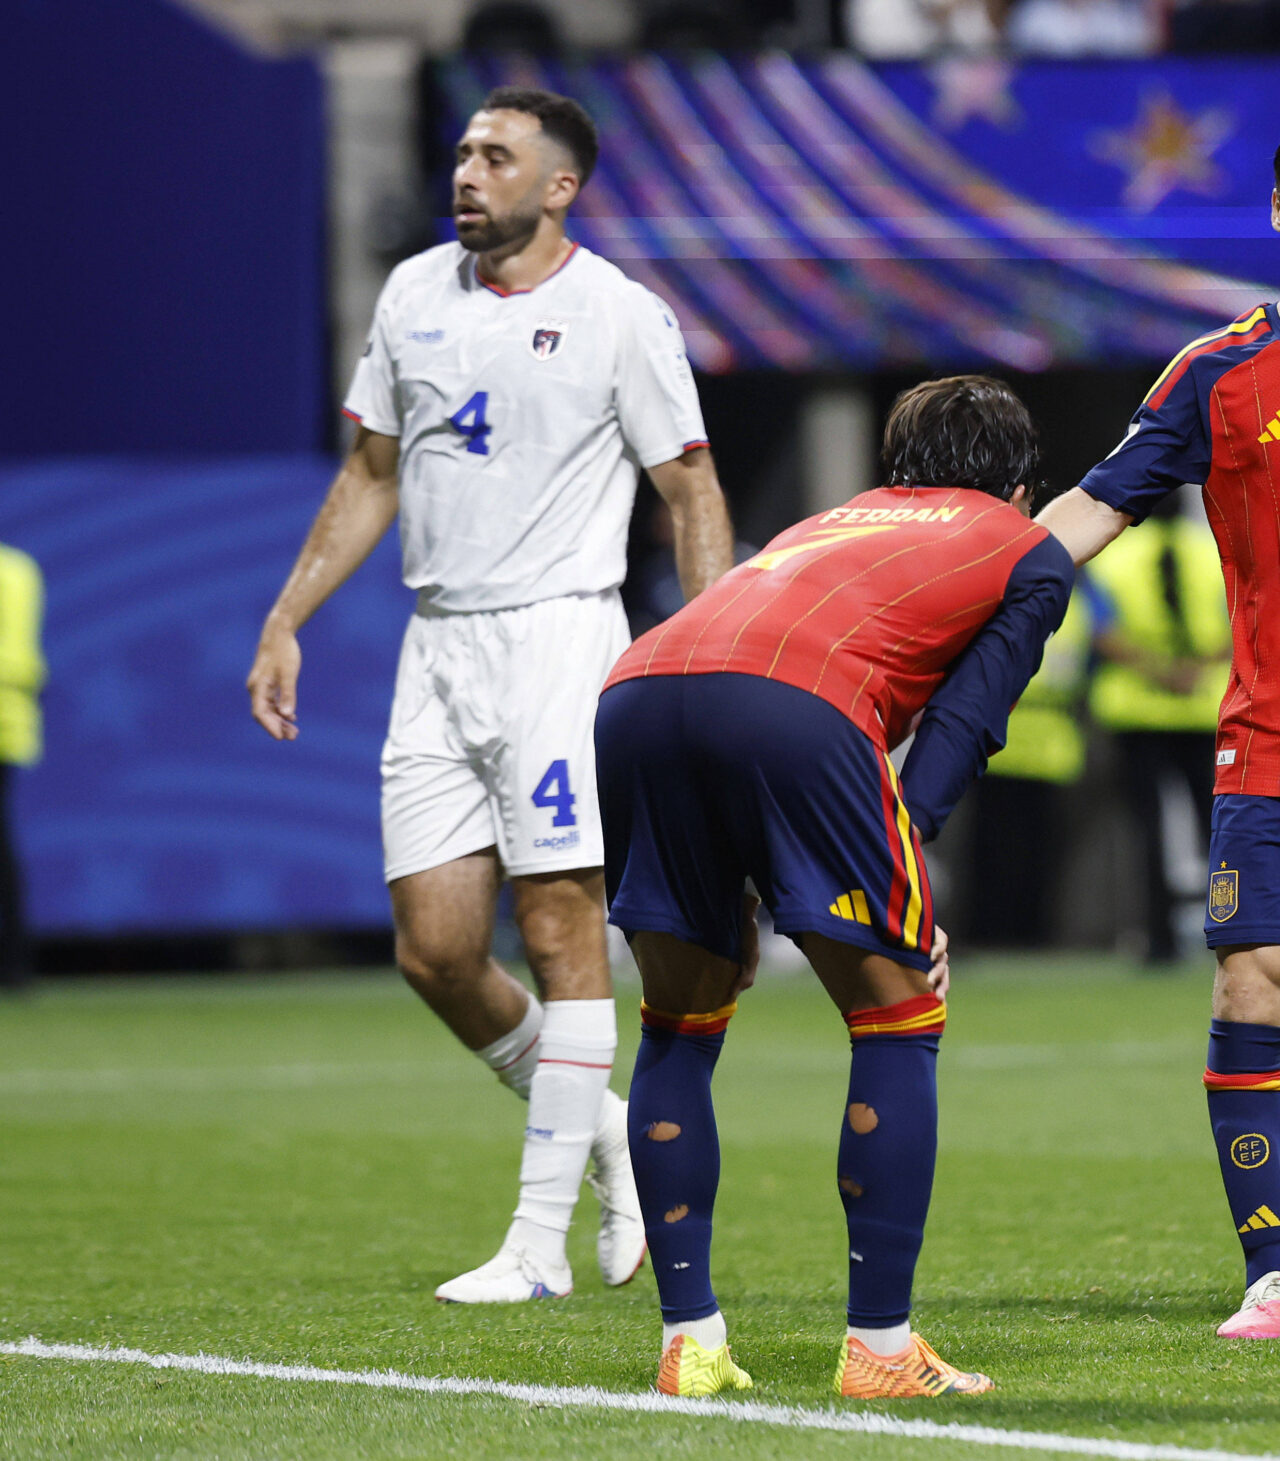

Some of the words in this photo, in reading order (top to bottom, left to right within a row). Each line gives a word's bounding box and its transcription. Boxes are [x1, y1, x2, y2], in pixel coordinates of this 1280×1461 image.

[449, 391, 491, 456] 4
[818, 506, 964, 524] FERRAN
[746, 525, 901, 571] 7
[531, 759, 577, 828] 4
